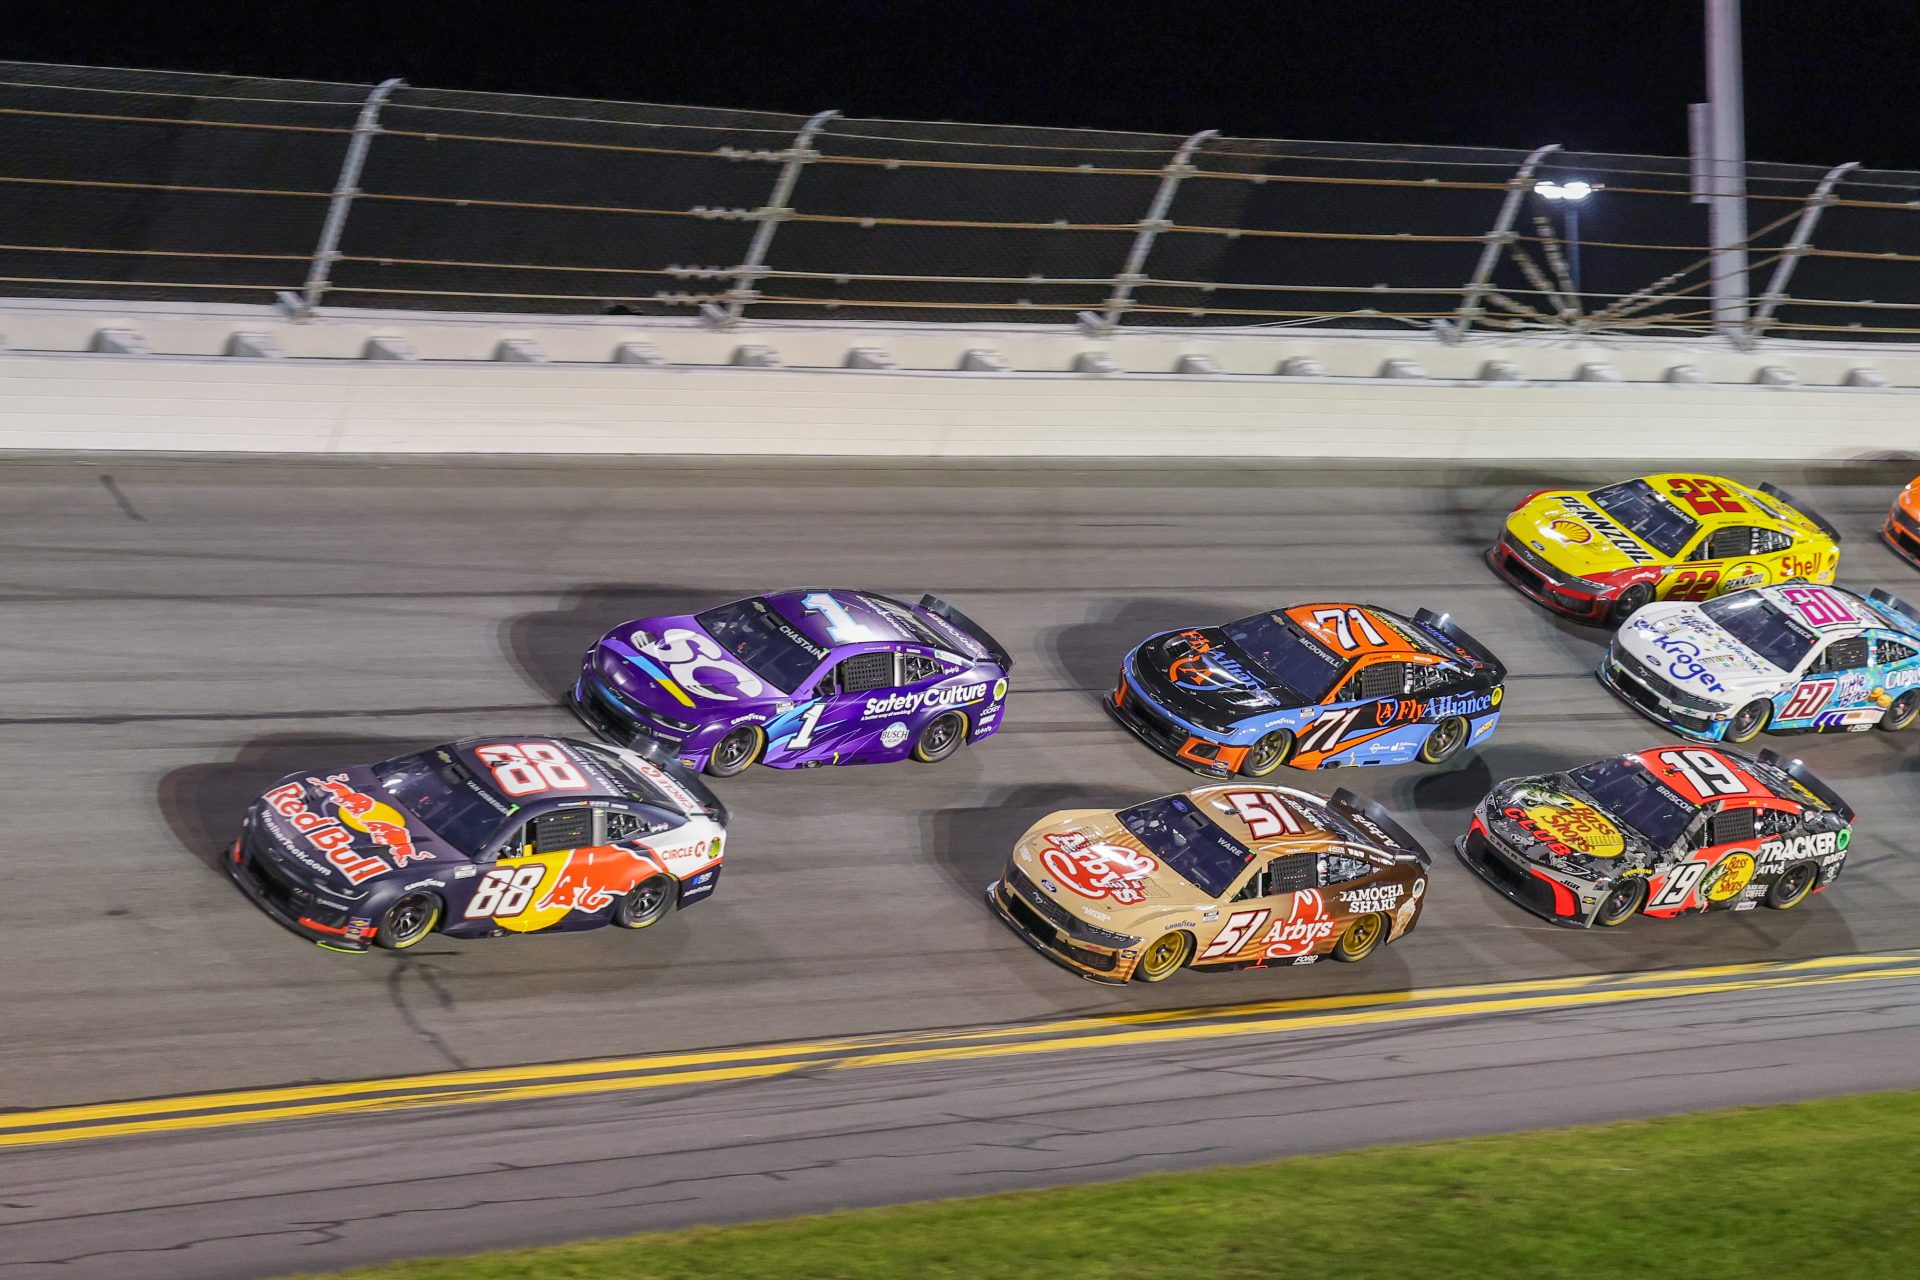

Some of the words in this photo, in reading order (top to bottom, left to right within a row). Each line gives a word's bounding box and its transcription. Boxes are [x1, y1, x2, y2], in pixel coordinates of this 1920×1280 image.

[1665, 503, 1694, 524] LOGANO
[1667, 479, 1748, 516] 22
[1549, 496, 1655, 564] PENNZOIL
[1780, 553, 1822, 577] Shell
[1662, 571, 1721, 600] 22
[1723, 573, 1764, 590] PENNZOIL
[801, 592, 876, 642] 1
[1781, 588, 1858, 627] 60
[779, 625, 823, 661] CHASTAIN
[1312, 608, 1389, 650] 71
[1784, 620, 1813, 640] PREECE
[1299, 637, 1341, 668] MCDOWELL
[1652, 635, 1725, 694] Kroger
[863, 683, 987, 715] SafetyCulture
[1777, 681, 1837, 721] 60
[731, 713, 766, 725] GOODYEAR
[786, 702, 827, 750] 1
[881, 730, 908, 740] BUSCH
[1265, 718, 1296, 728] GOODYEAR
[1300, 708, 1362, 753] 71
[475, 742, 590, 797] 88
[1659, 749, 1750, 798] 19
[1655, 785, 1695, 813] BRISCOE
[1224, 792, 1304, 840] 51
[1503, 807, 1573, 856] CLUB
[1558, 810, 1592, 833] Pro
[1570, 807, 1615, 836] Bass
[261, 810, 332, 876] WeatherTech.com
[262, 782, 341, 835] Red
[305, 825, 394, 886] Bull
[1217, 837, 1242, 857] WARE
[1489, 835, 1526, 864] CAMRY
[1759, 831, 1836, 863] TRACKER
[661, 845, 693, 860] CIRCLE
[1048, 834, 1142, 902] Arby's
[464, 863, 547, 920] 88
[1339, 884, 1404, 902] JAMOCHA
[1560, 880, 1580, 890] JGR
[1648, 862, 1708, 907] 19
[1349, 898, 1396, 913] SHAKE
[1165, 920, 1196, 931] GOODYEAR
[1198, 908, 1271, 960] 51
[1262, 914, 1333, 945] Arby's
[1295, 955, 1318, 963] FORD
